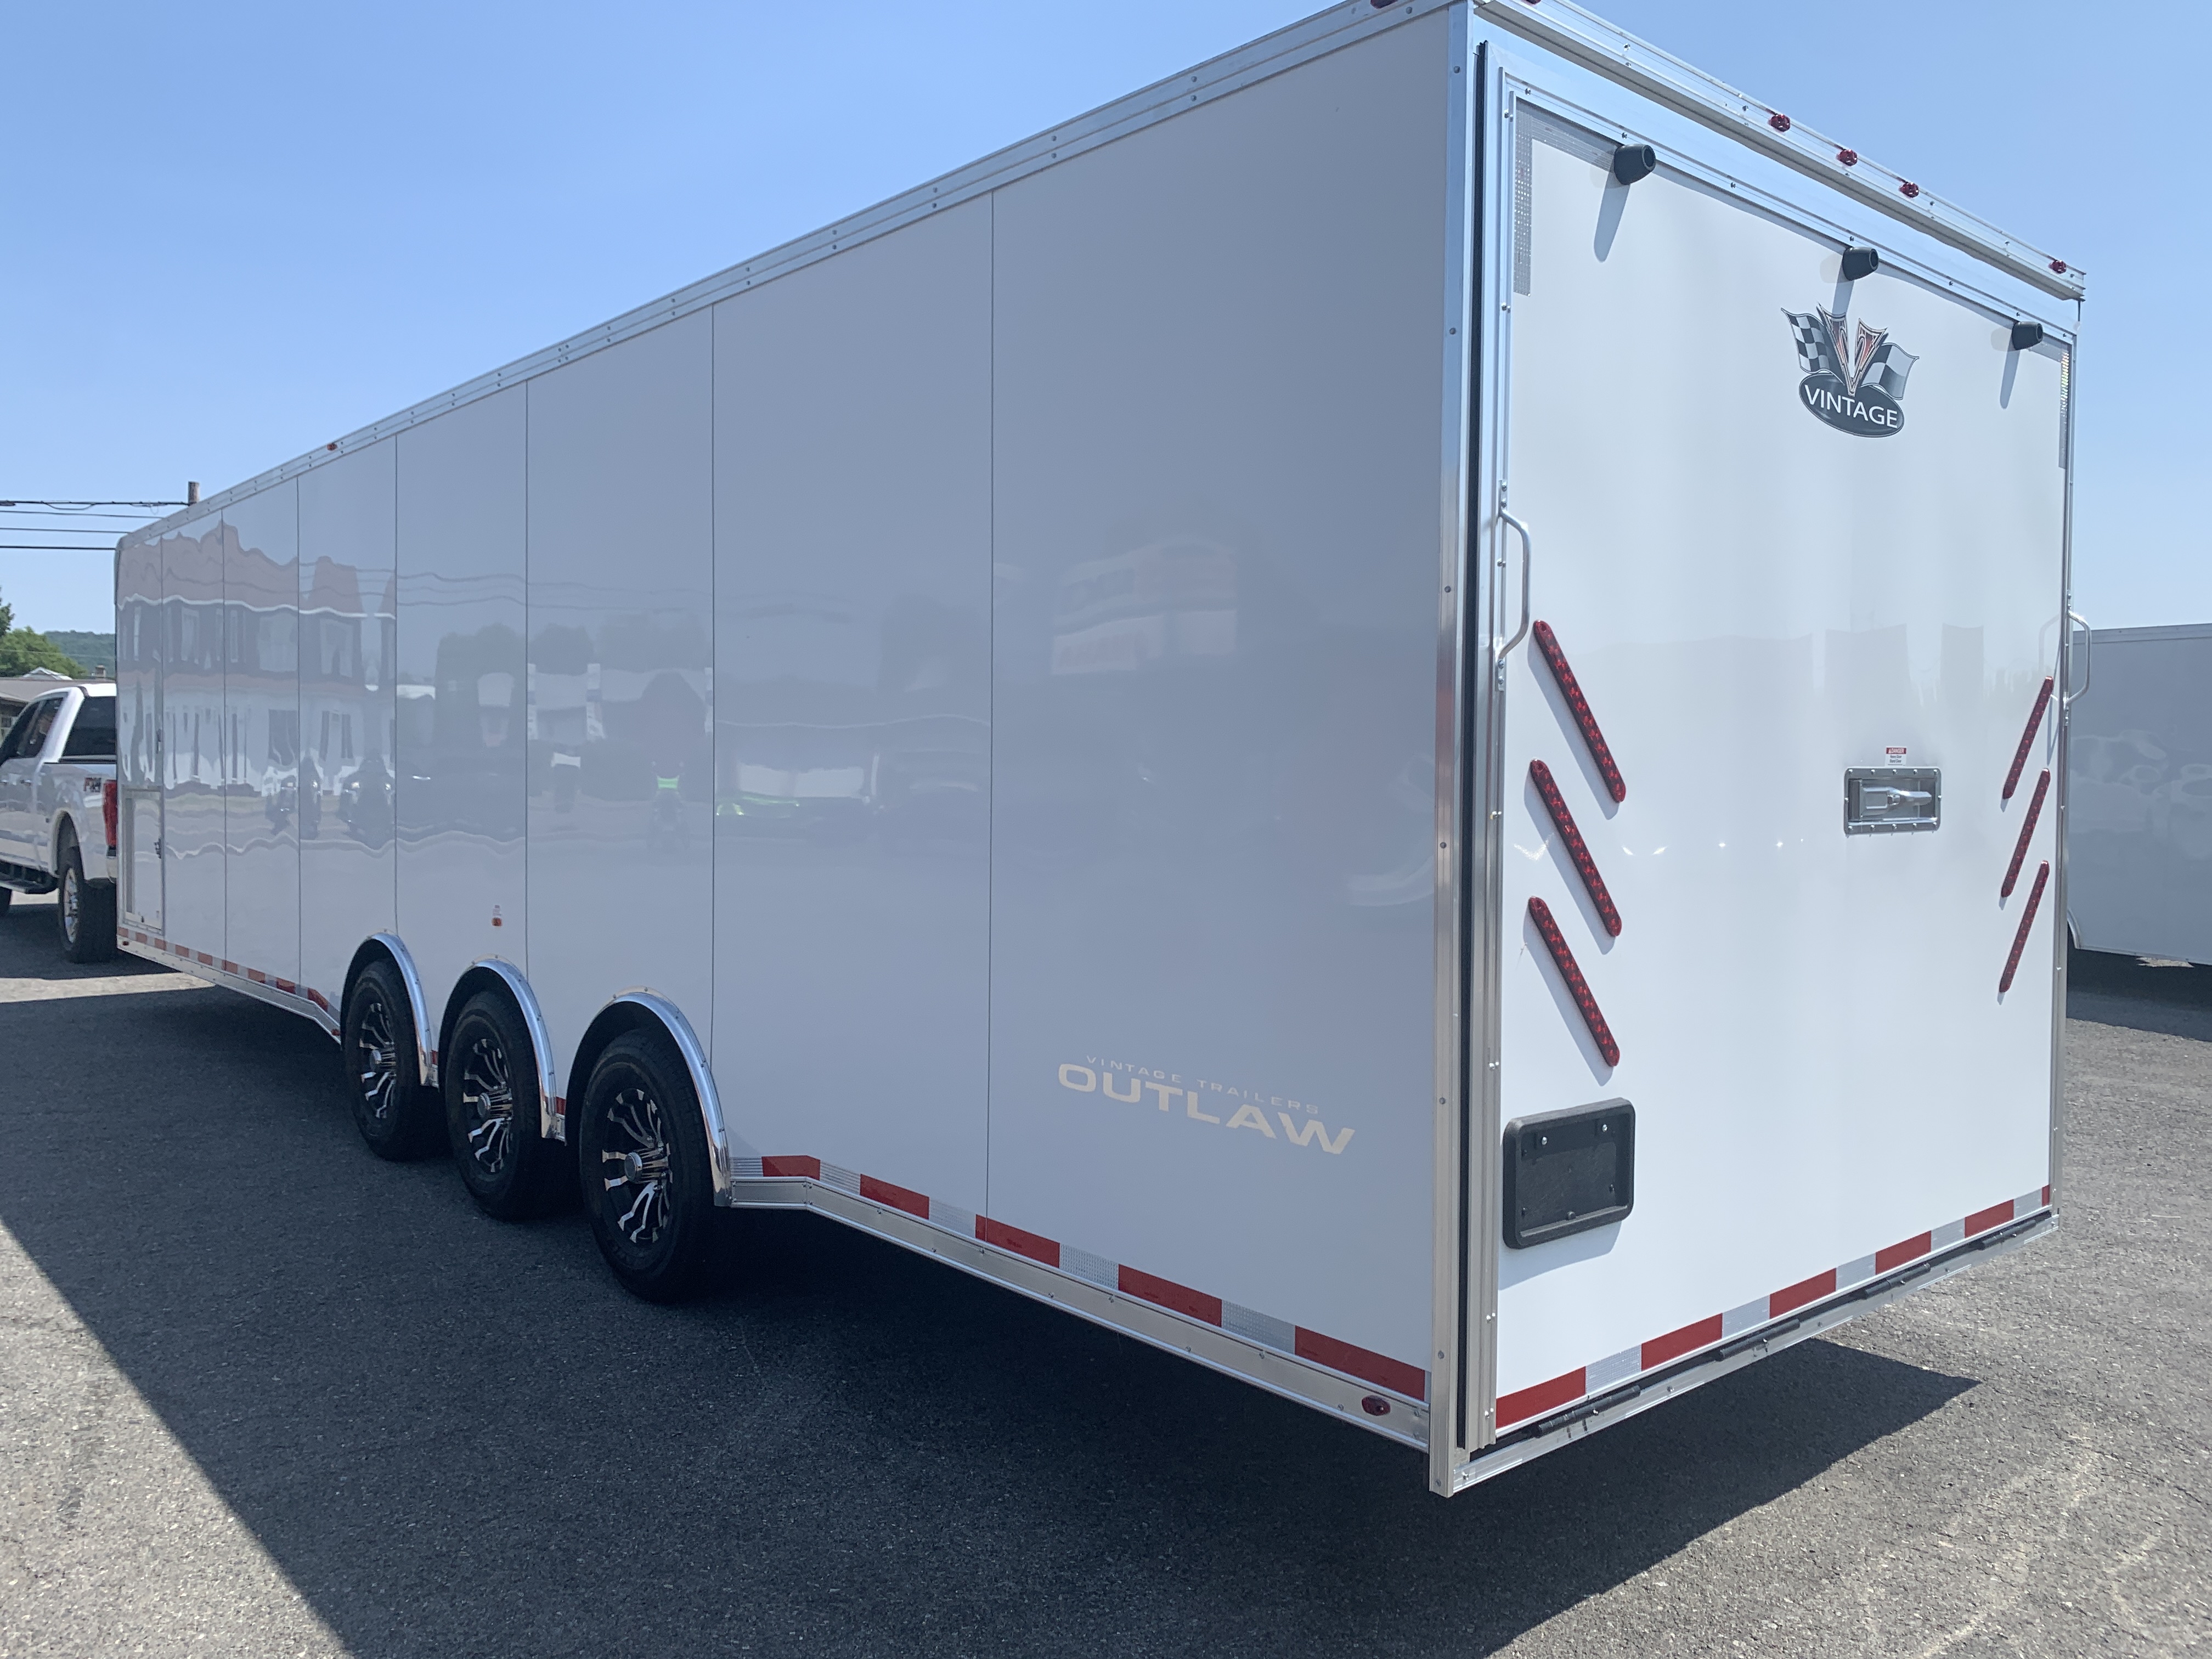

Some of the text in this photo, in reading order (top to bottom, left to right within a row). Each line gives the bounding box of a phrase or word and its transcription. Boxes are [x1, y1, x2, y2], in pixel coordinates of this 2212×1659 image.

[1804, 385, 1898, 428] VINTAGE
[1058, 1063, 1356, 1154] OUTLAW
[1086, 1055, 1318, 1115] VINTAGE TRAILERS
